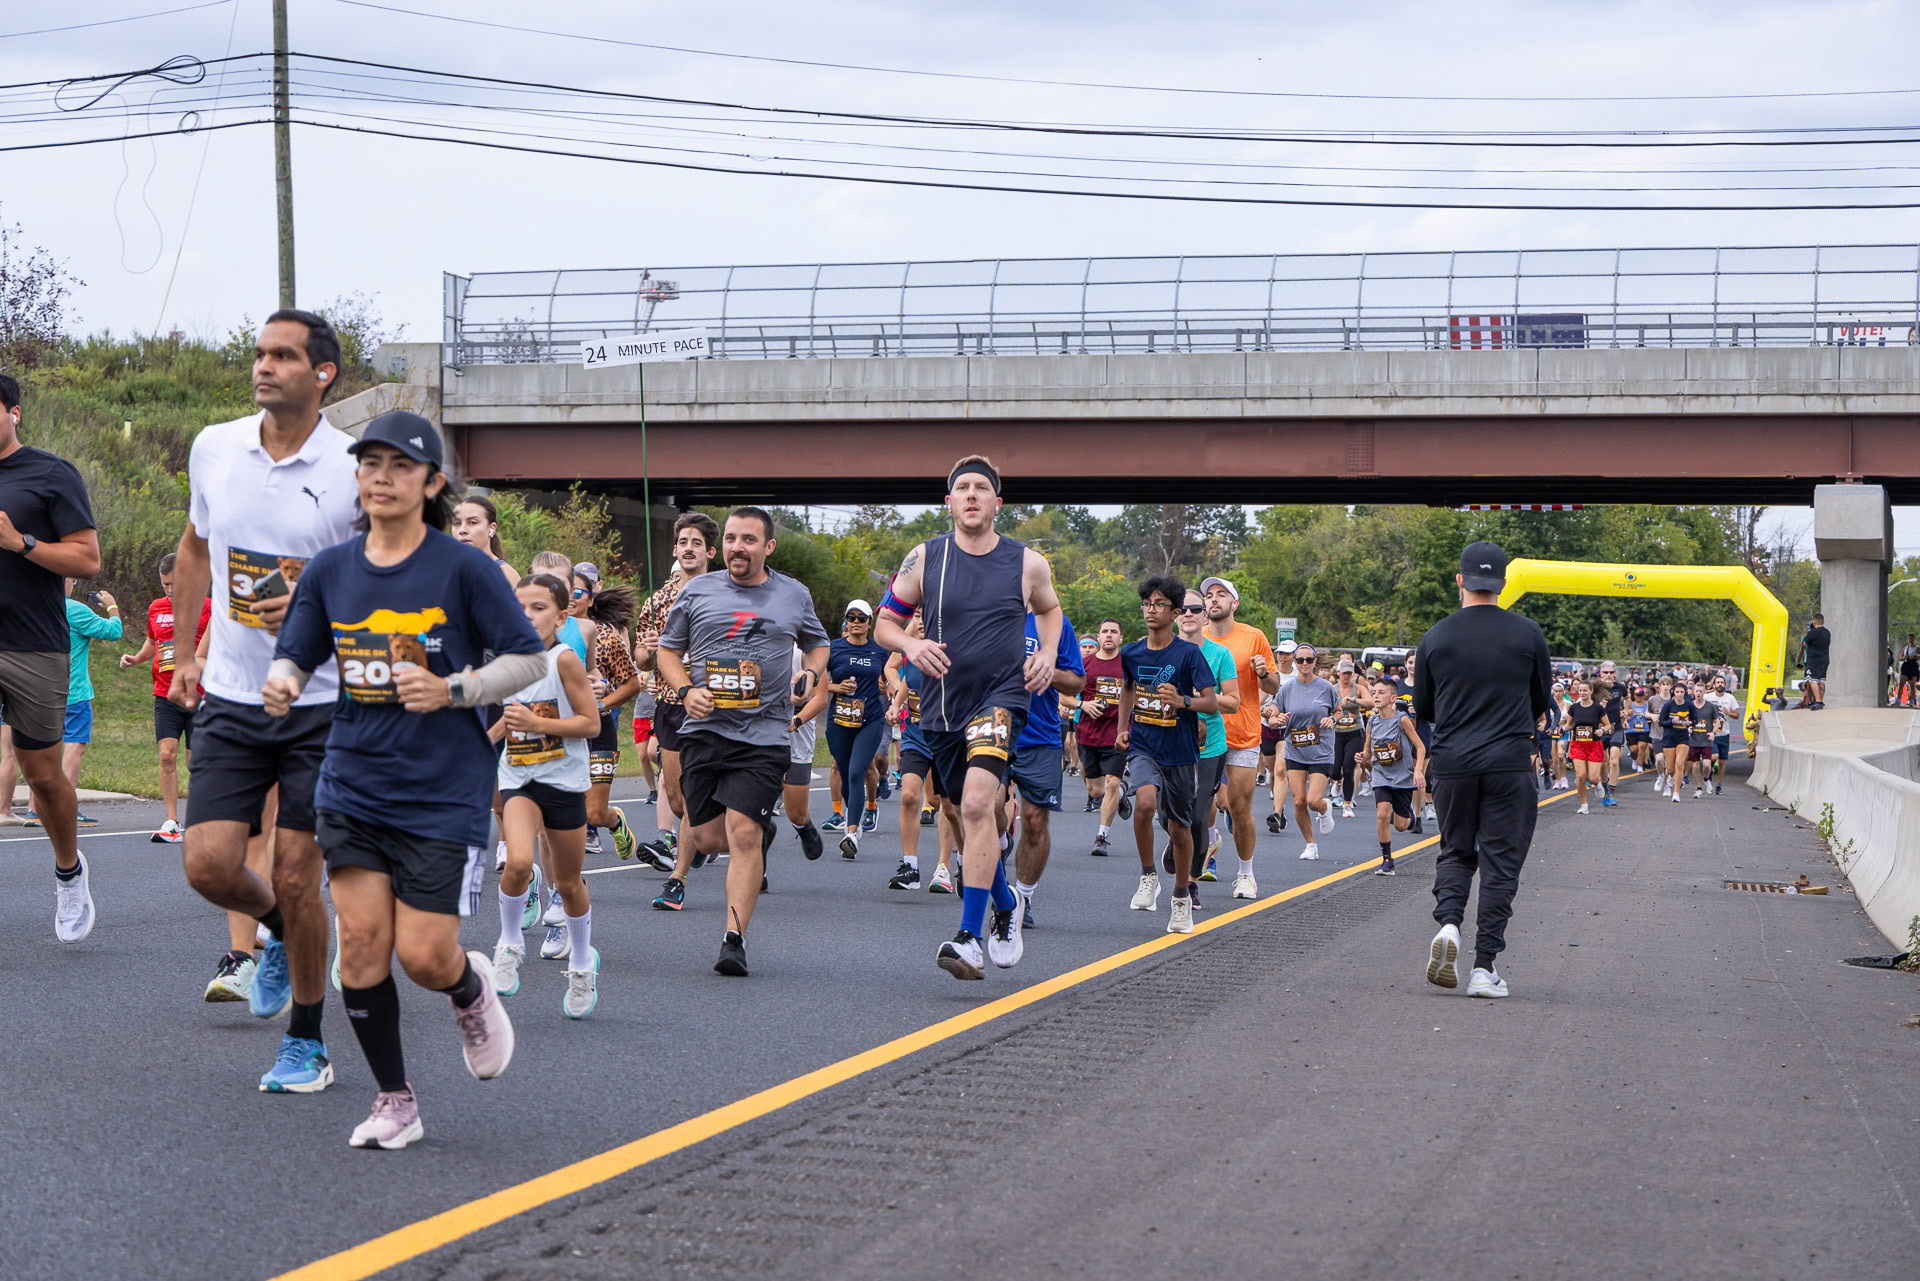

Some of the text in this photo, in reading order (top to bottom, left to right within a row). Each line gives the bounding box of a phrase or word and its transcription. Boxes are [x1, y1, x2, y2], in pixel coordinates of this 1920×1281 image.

[585, 337, 704, 364] 24 MINUTE PACE
[230, 552, 248, 561] THE
[229, 561, 261, 574] CHASE
[337, 647, 371, 657] CHASE
[849, 658, 871, 667] F45
[708, 674, 756, 690] 255
[836, 705, 862, 717] 244
[966, 722, 1008, 740] 344
[1294, 732, 1315, 742] 128
[1377, 750, 1397, 760] 127
